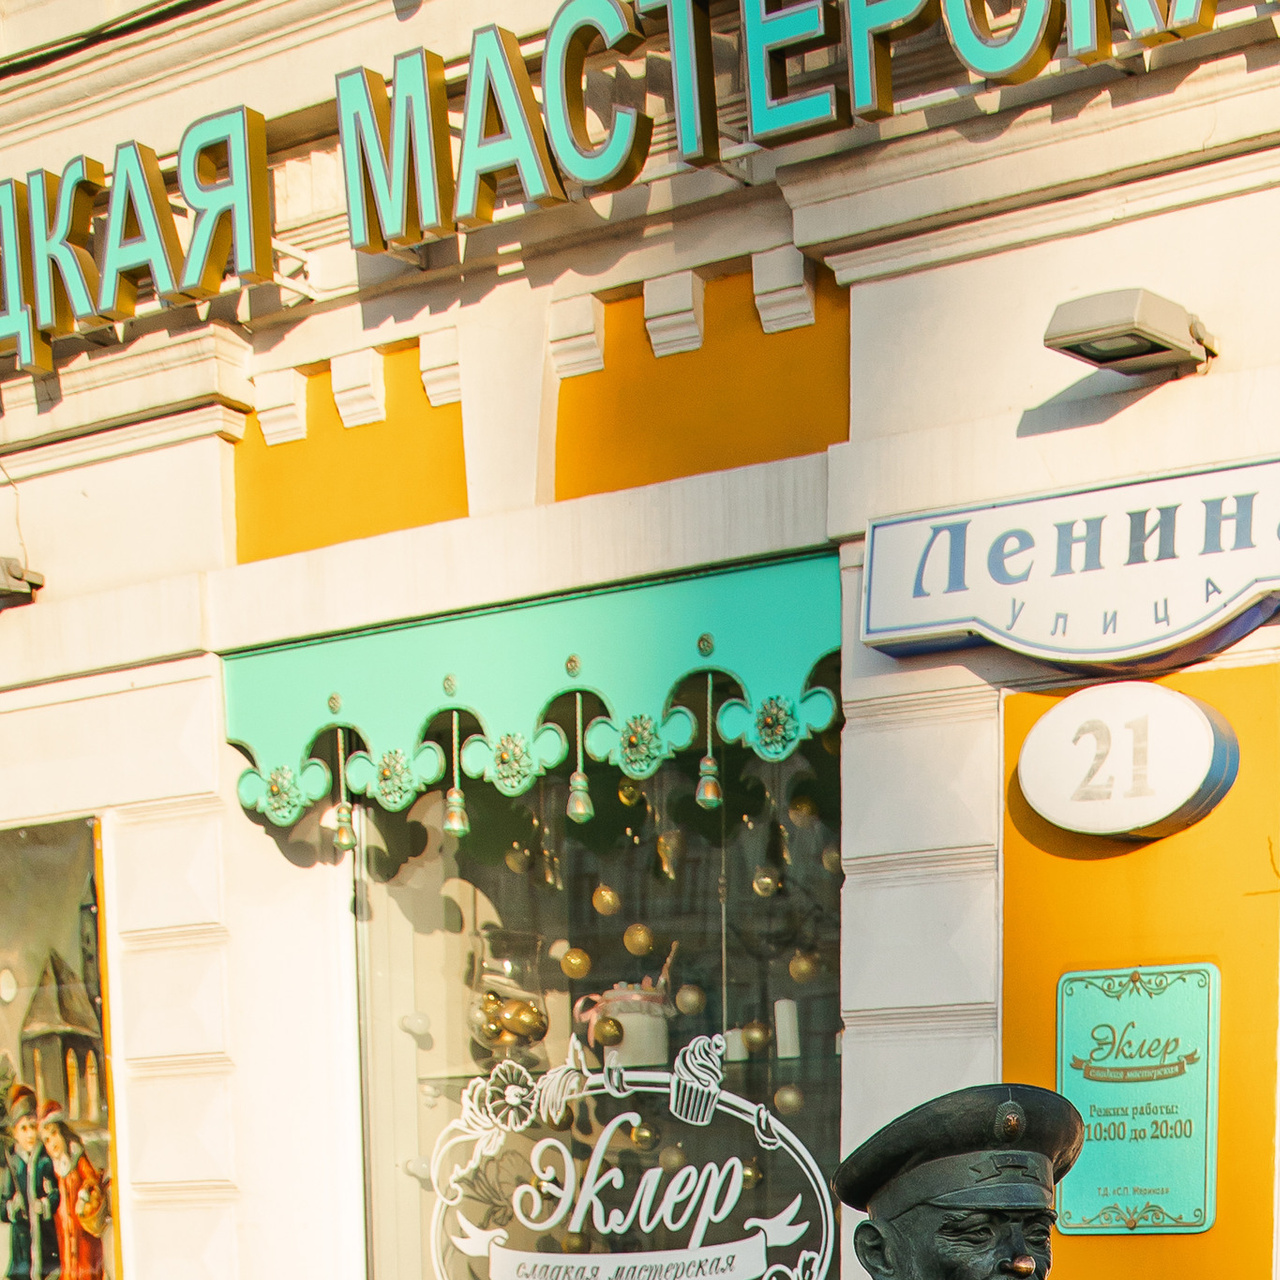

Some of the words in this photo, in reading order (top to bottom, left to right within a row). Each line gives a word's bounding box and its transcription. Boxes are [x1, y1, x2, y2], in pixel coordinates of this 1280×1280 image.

[334, 0, 1202, 253] МАСТЕР
[1070, 714, 1156, 802] 21
[1088, 1021, 1180, 1066] Эклер
[1085, 1121, 1127, 1142] 10:00
[1129, 1128, 1147, 1142] до
[1150, 1119, 1193, 1140] 20:00
[1089, 1104, 1129, 1118] Режим
[1131, 1102, 1179, 1119] работы:
[511, 1111, 744, 1250] Эклер
